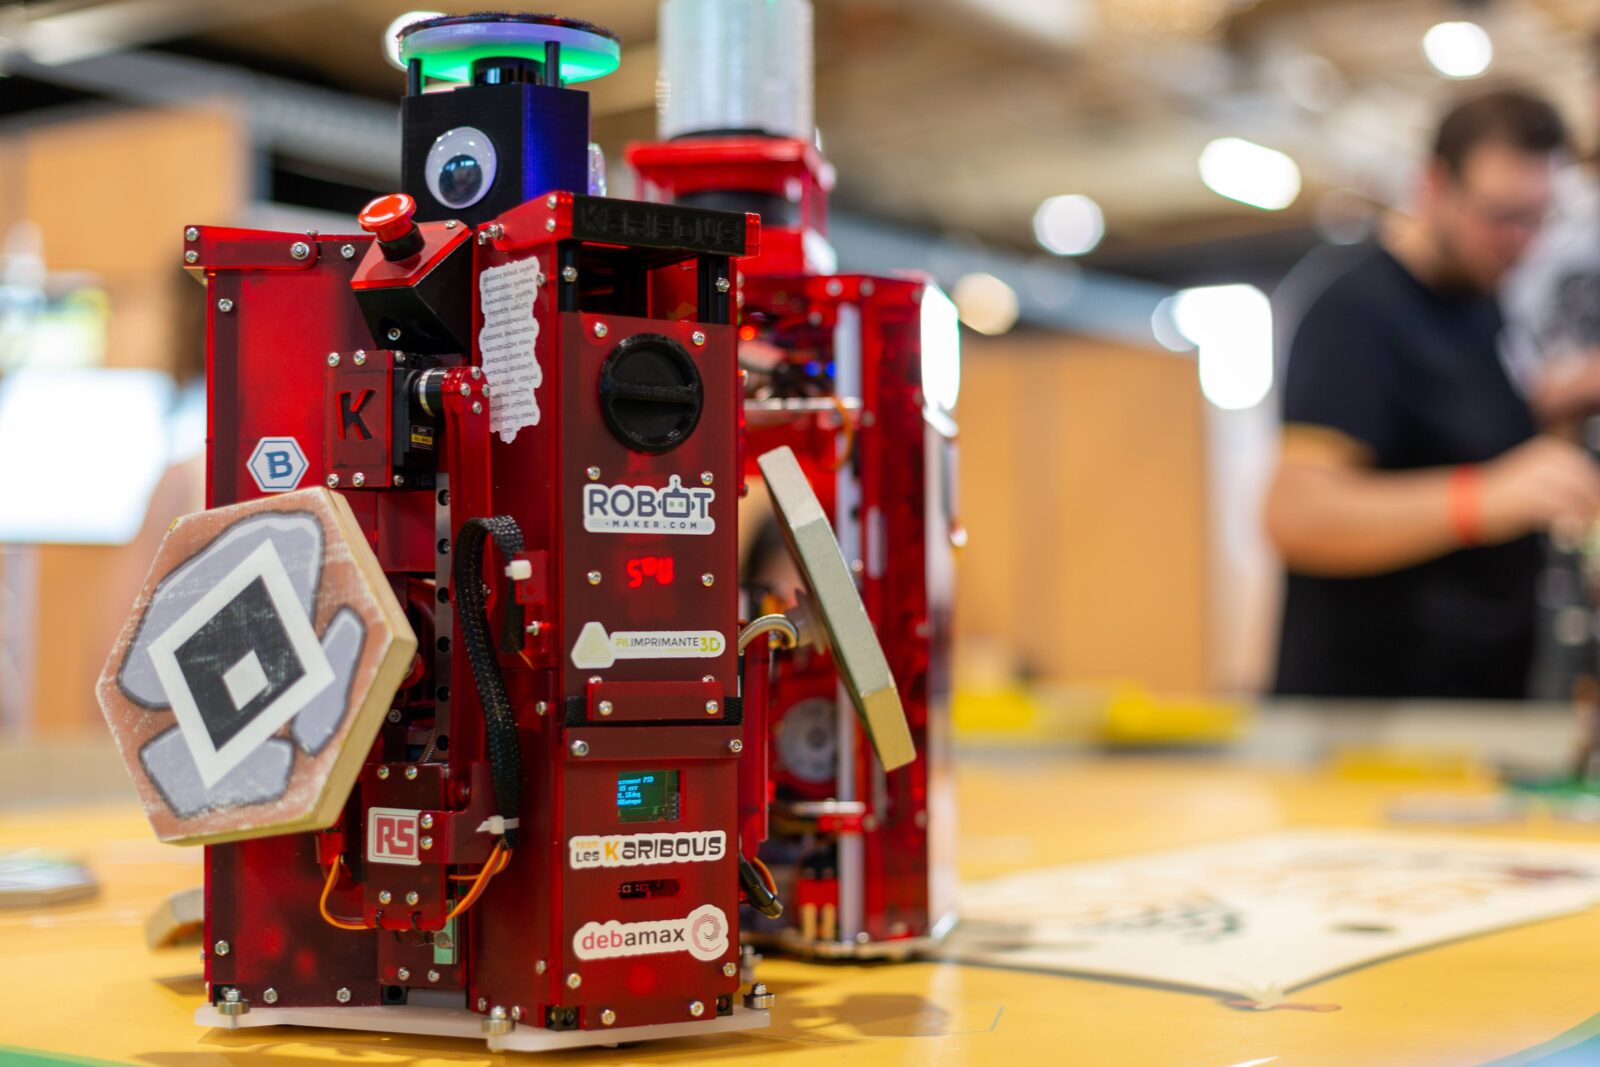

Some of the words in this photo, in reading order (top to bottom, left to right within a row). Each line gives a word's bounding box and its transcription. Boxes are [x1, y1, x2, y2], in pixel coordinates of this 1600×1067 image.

[335, 389, 376, 441] K
[265, 450, 293, 480] B
[375, 816, 415, 857] RS
[582, 927, 685, 950] debamax
